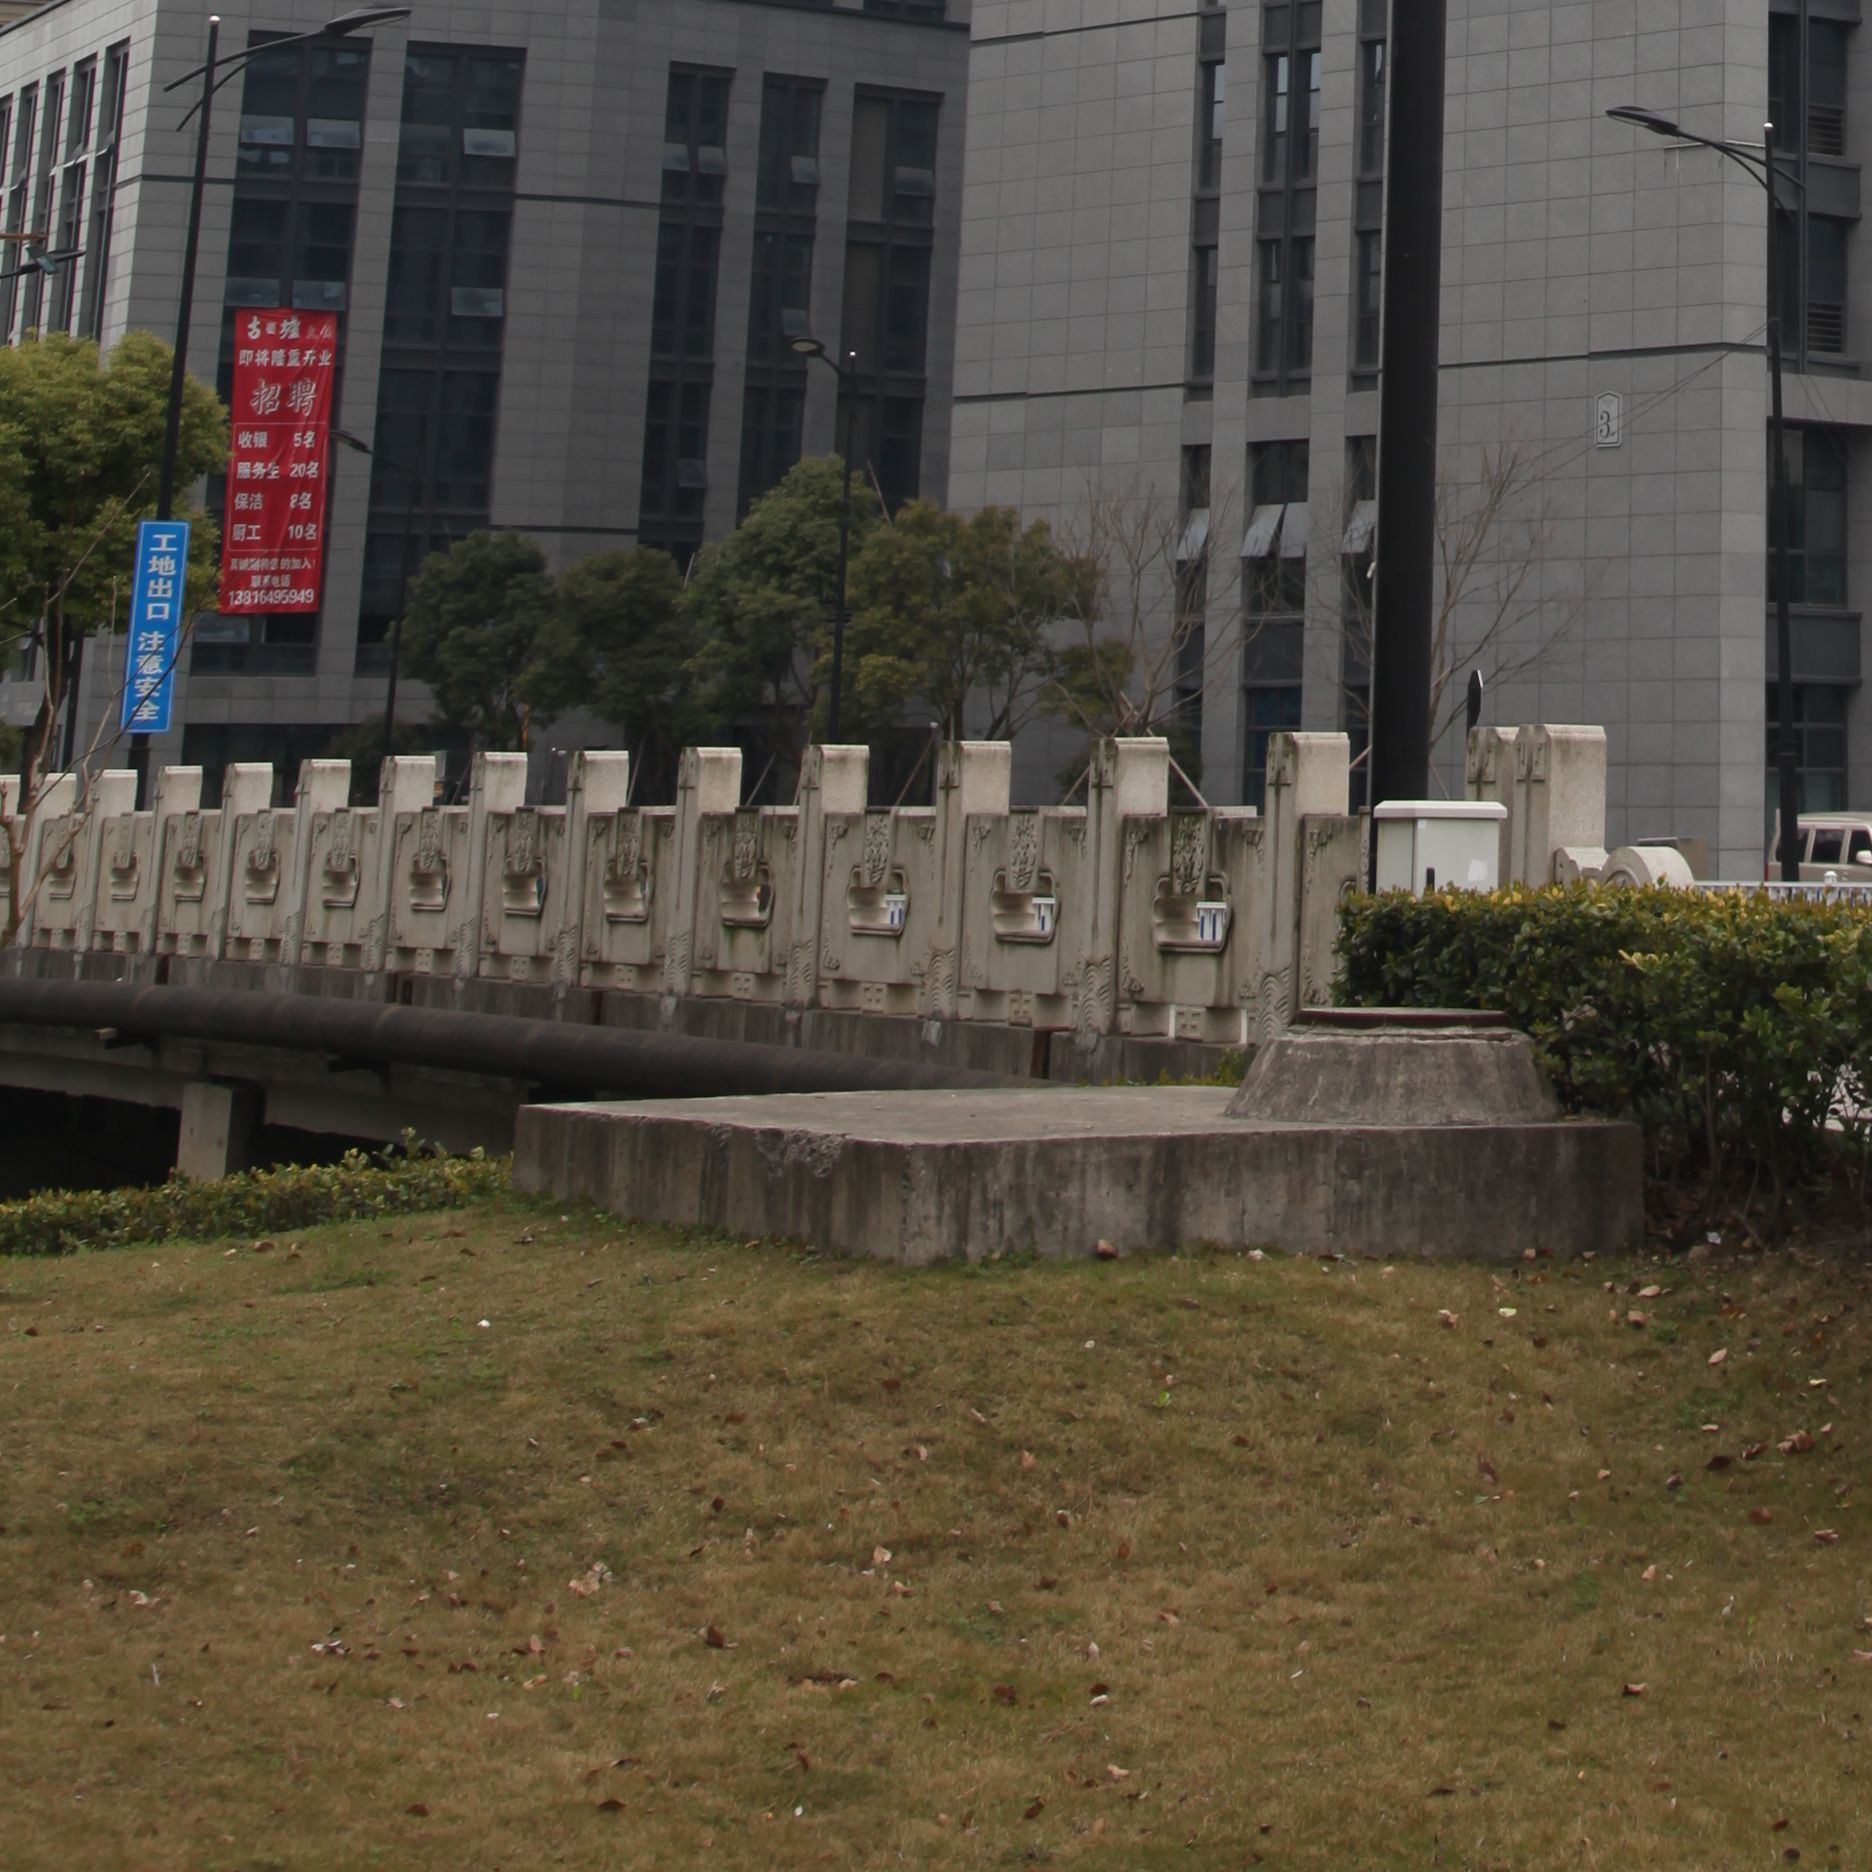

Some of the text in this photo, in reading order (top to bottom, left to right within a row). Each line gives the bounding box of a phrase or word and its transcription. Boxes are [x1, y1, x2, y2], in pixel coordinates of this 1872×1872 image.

[249, 378, 317, 417] 招聘
[238, 431, 315, 448] 收银 5名
[236, 461, 319, 479] 服务生 20名
[234, 492, 263, 510] 保洁
[232, 523, 318, 541] 厨工 10名
[132, 533, 178, 721] 工地出口 注意安全
